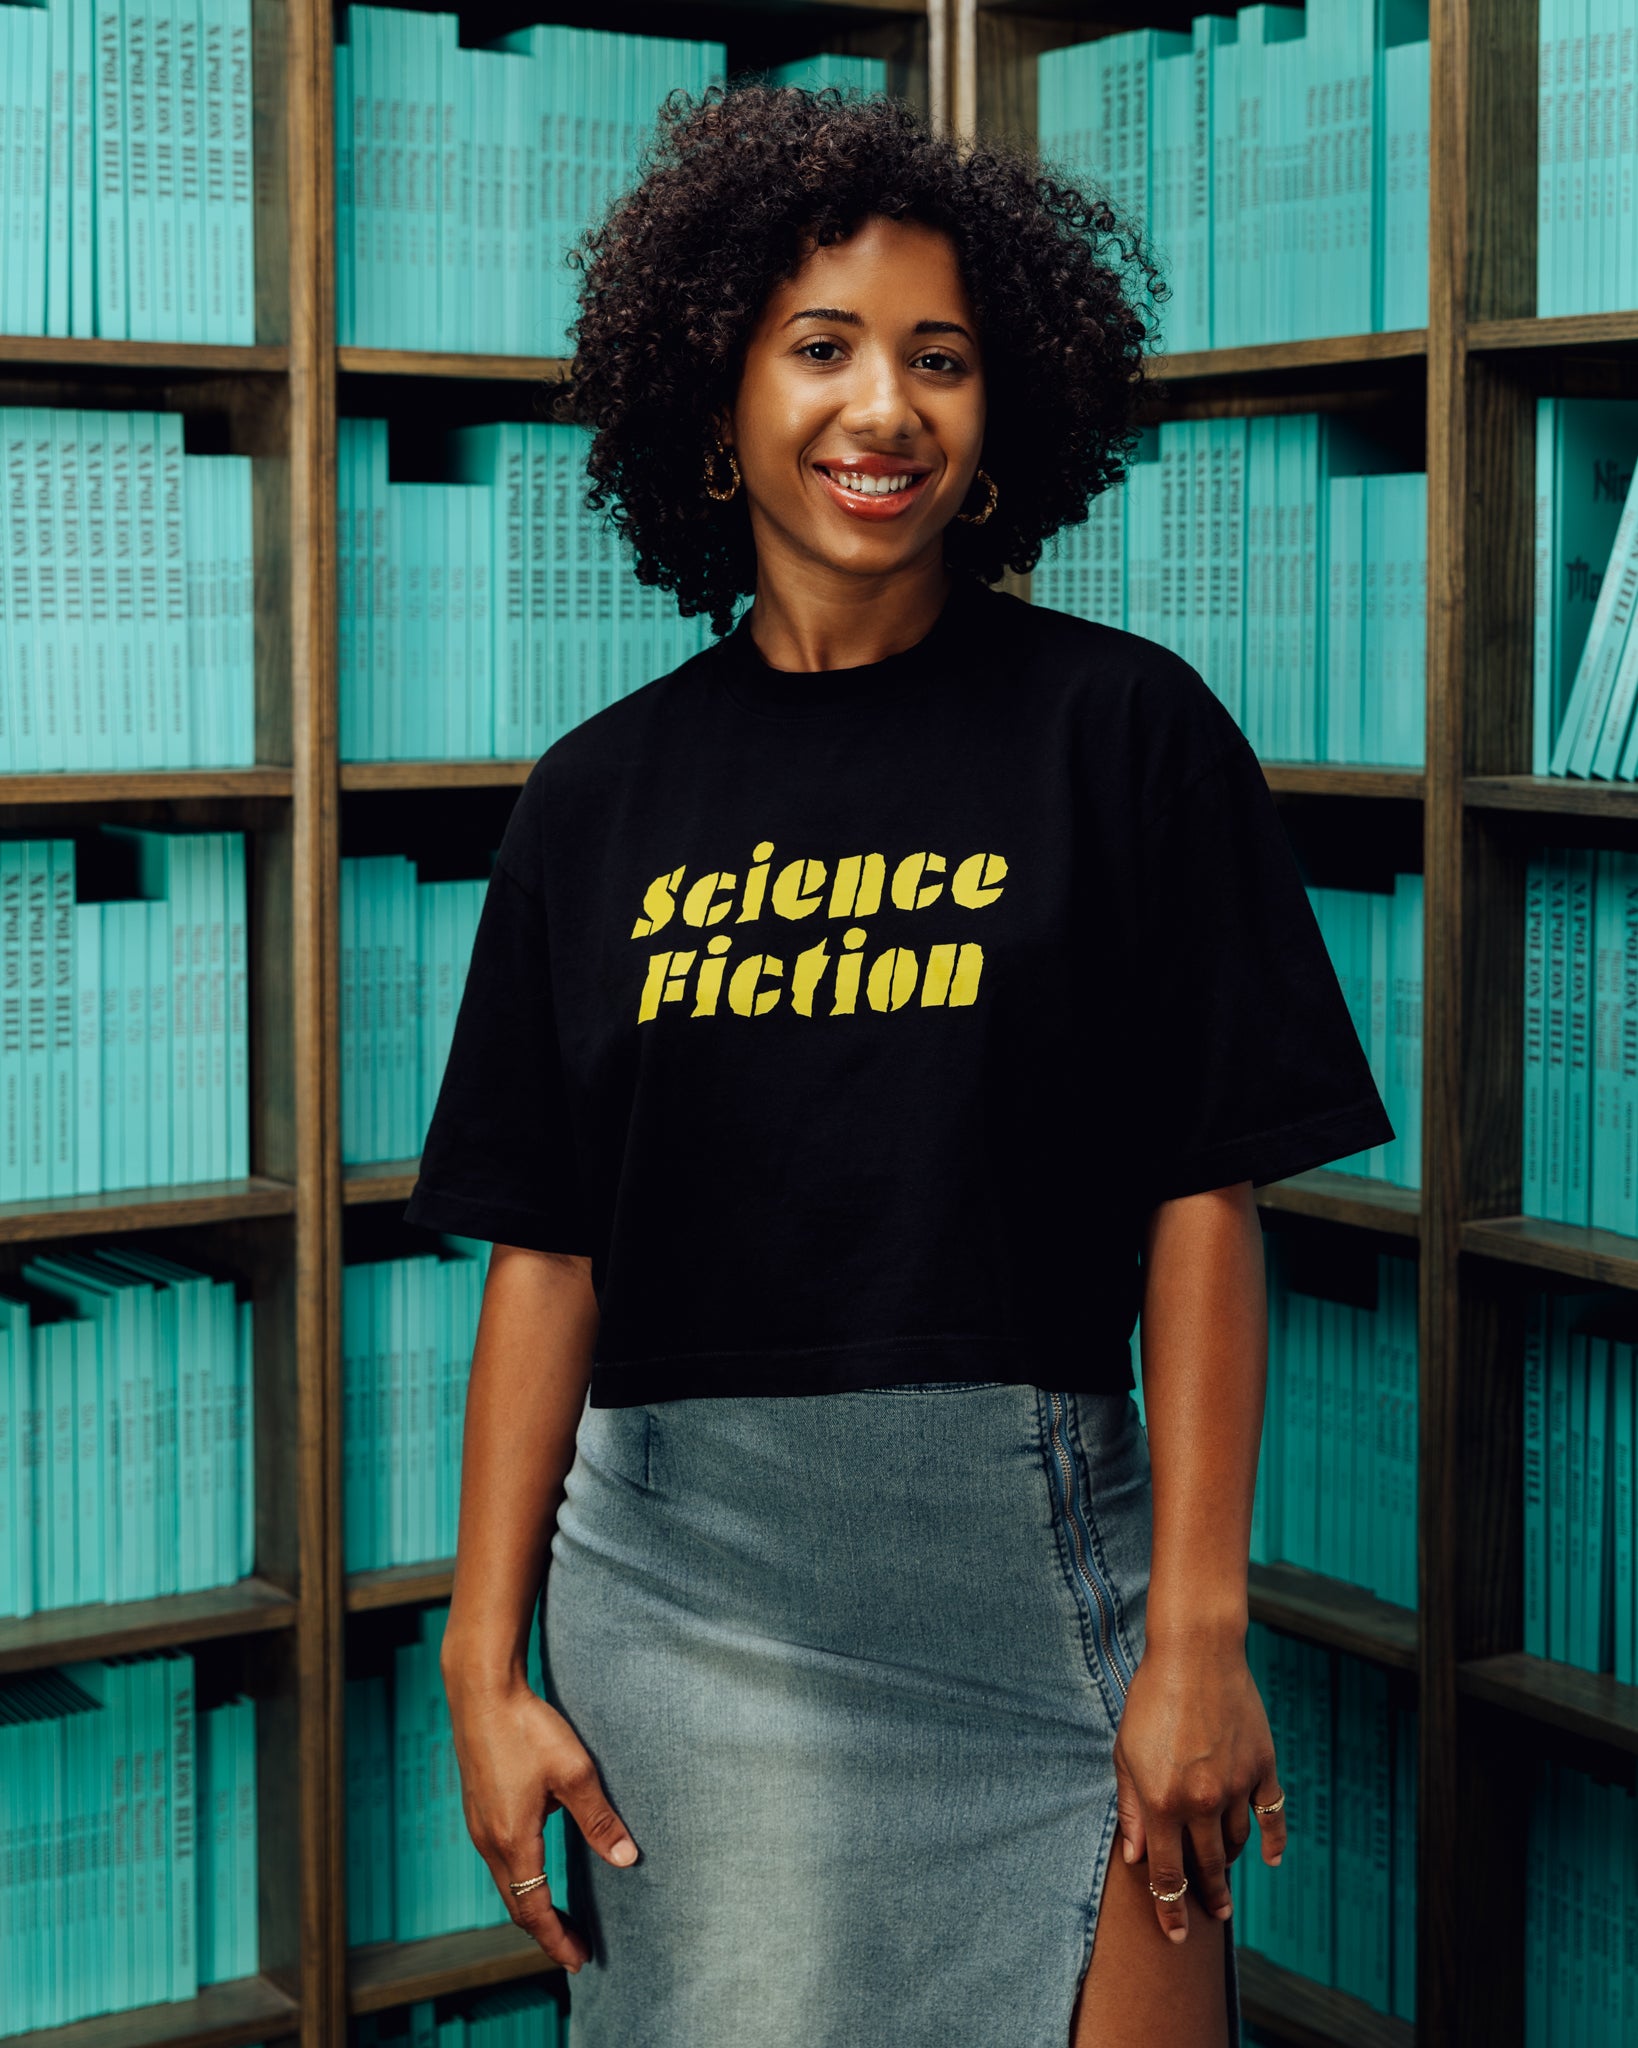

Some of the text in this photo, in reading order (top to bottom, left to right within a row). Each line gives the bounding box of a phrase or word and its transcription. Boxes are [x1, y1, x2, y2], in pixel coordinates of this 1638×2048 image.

[637, 927, 984, 1025] Fiction
[1527, 1008, 1541, 1066] HILL
[1550, 1009, 1564, 1067] HILL
[1572, 1013, 1585, 1072] HILL
